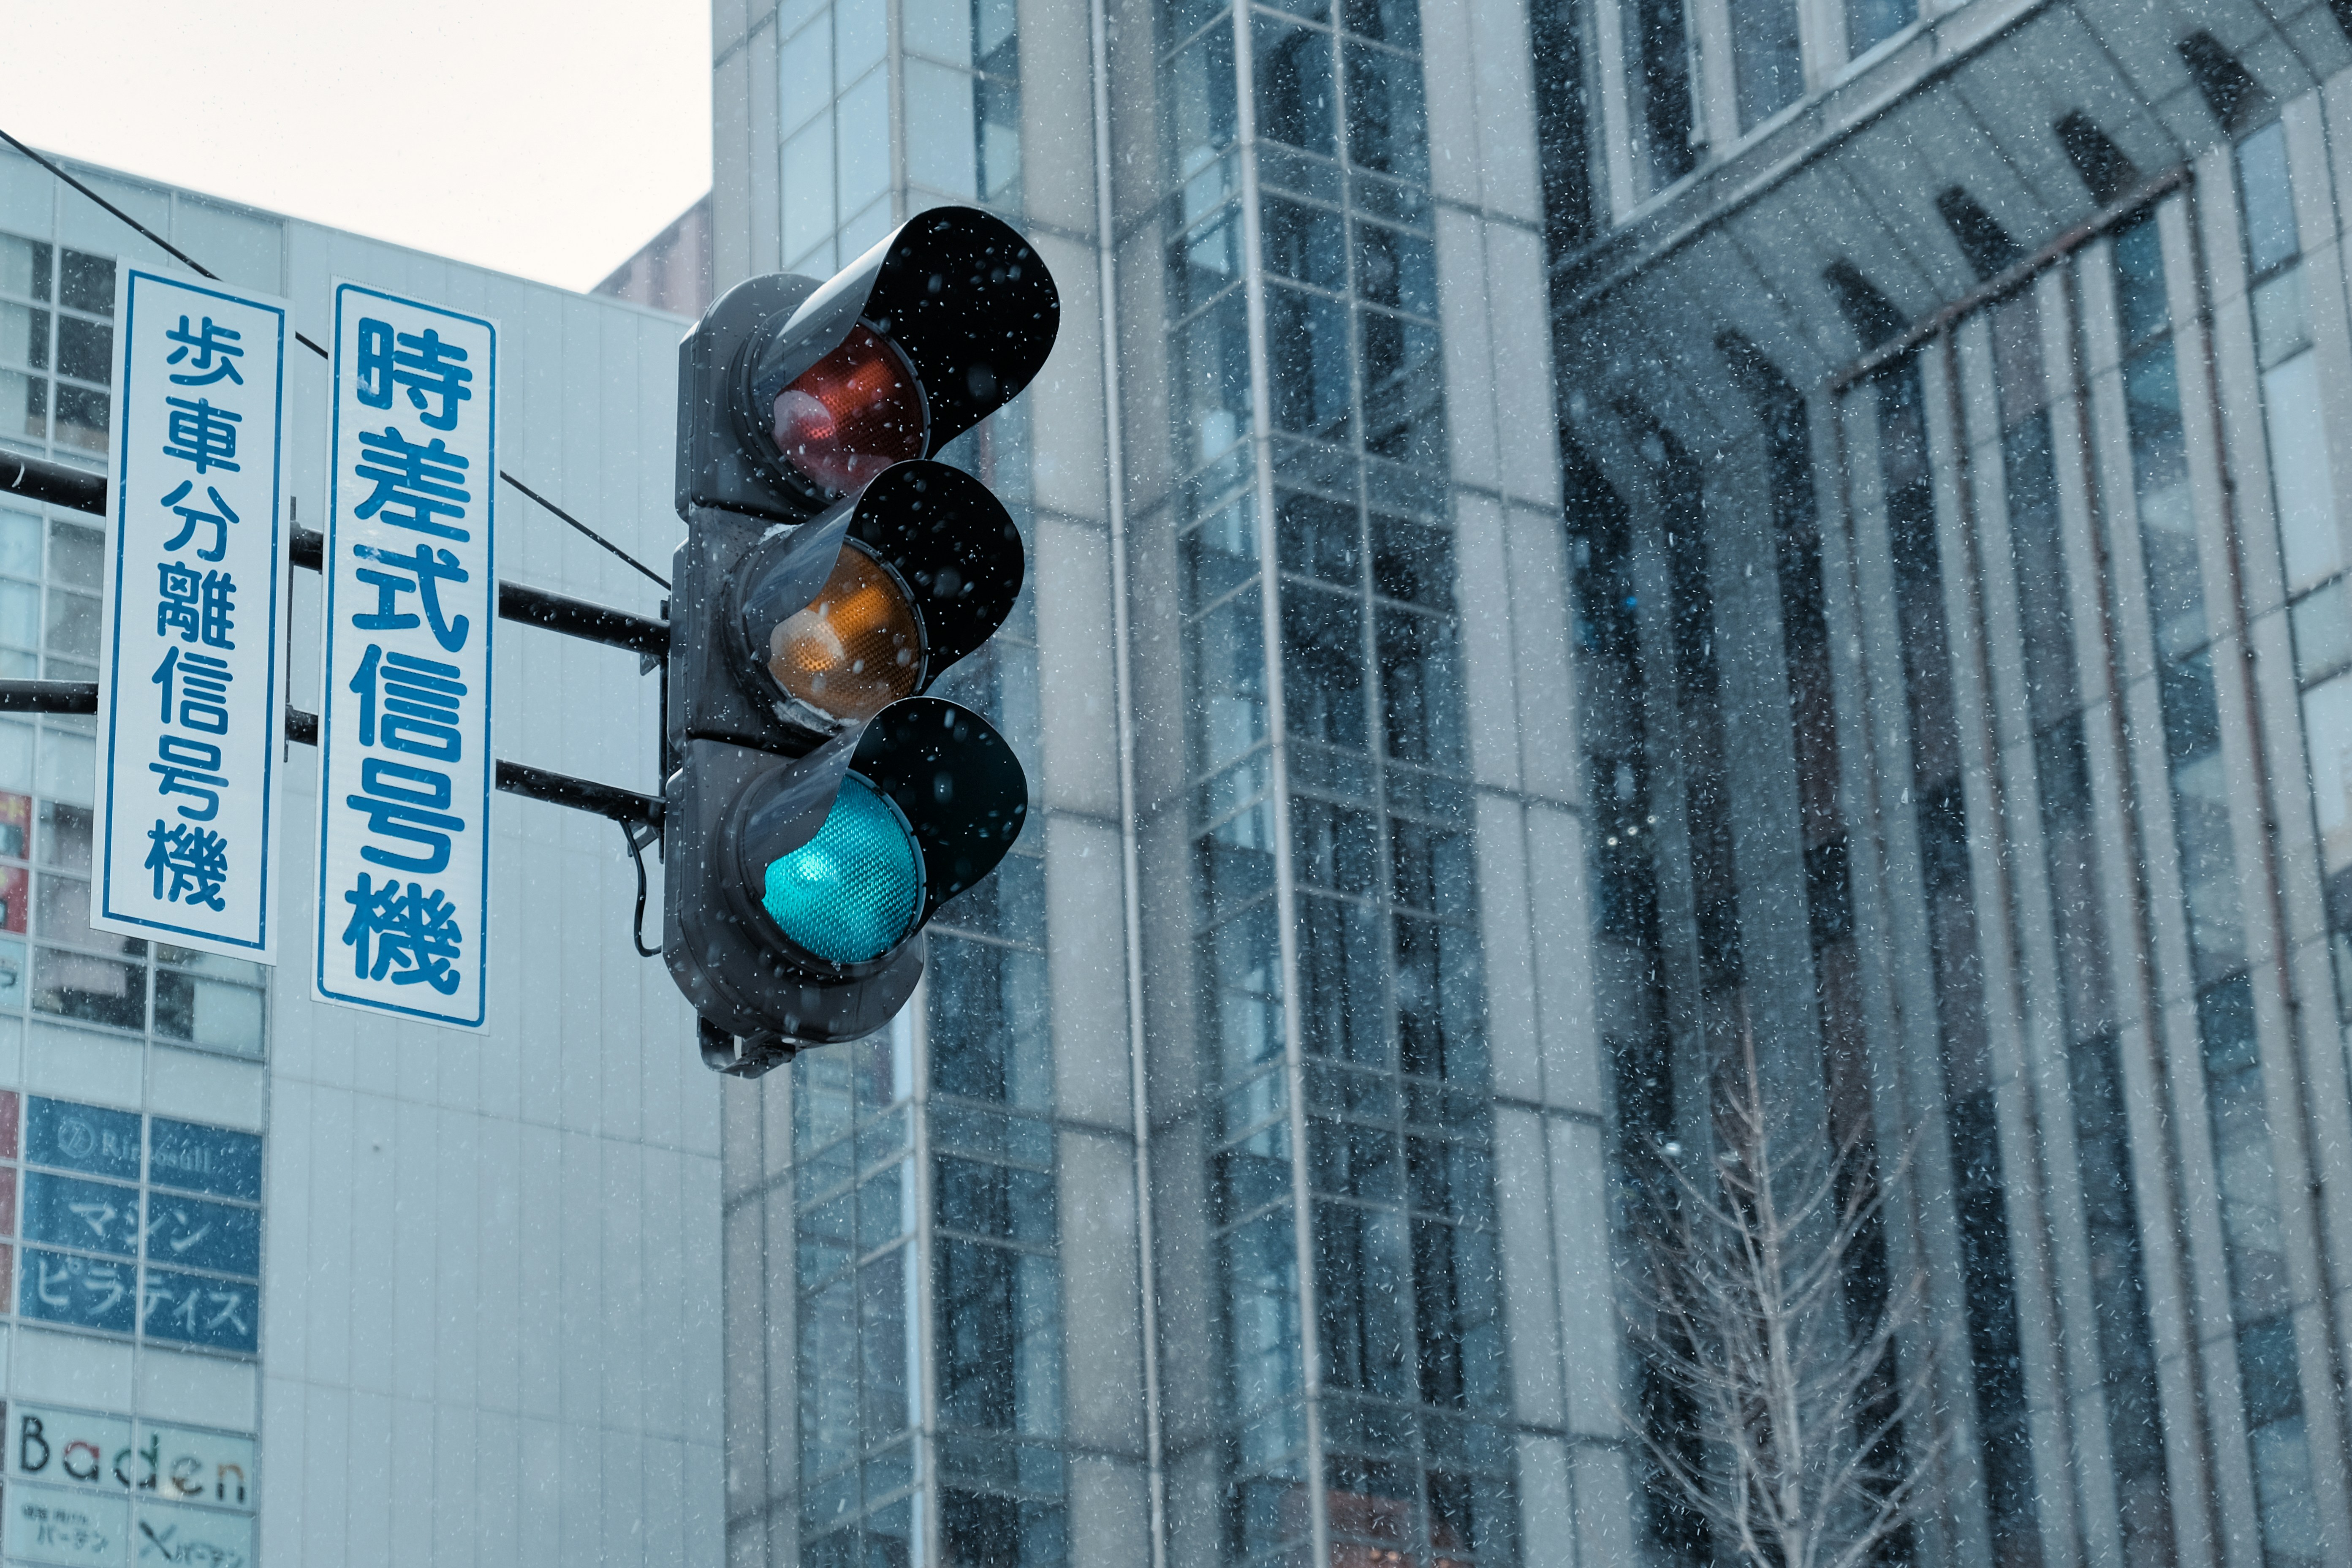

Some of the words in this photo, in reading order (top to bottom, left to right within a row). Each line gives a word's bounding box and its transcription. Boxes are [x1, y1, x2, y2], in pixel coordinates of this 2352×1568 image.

[144, 315, 244, 912] 歩車分離信号機
[342, 317, 473, 996] 時差式信号機
[69, 1200, 211, 1252] マシン
[38, 1256, 248, 1335] ピラティス
[20, 1414, 246, 1503] Baden
